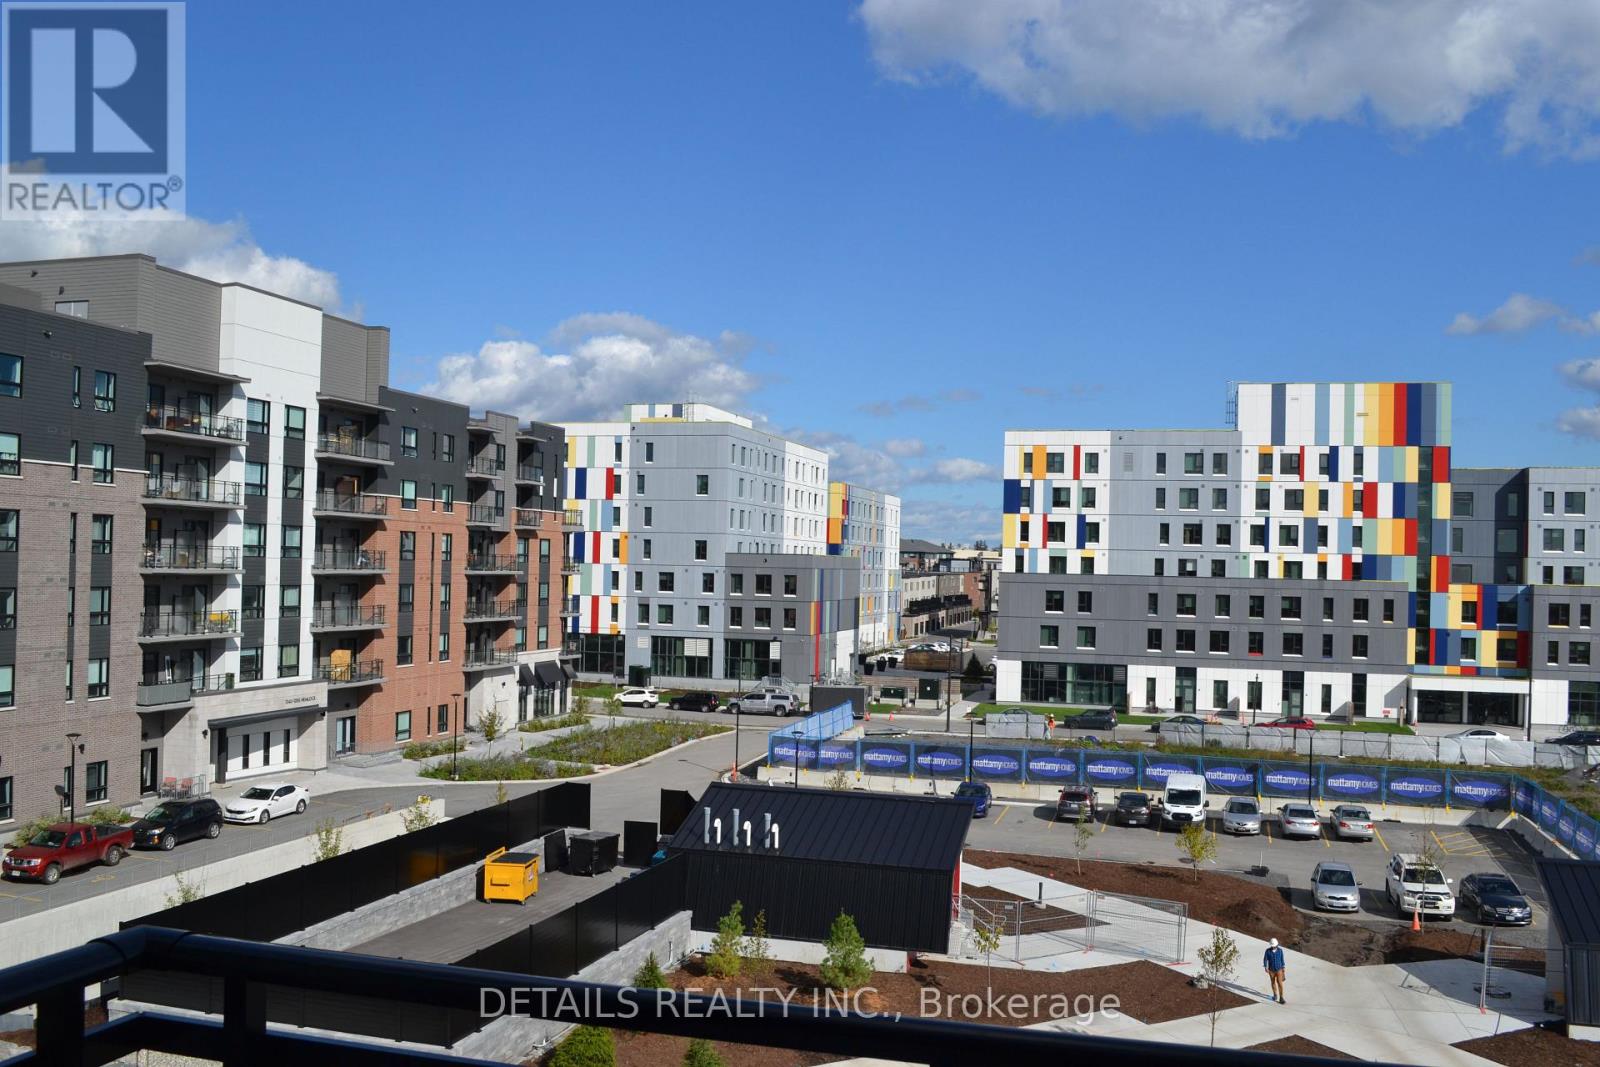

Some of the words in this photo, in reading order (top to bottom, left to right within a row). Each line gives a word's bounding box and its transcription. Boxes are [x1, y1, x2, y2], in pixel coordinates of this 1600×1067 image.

[863, 752, 907, 764] mattamyHOMES
[973, 758, 1019, 770] mattamyHOMES
[1030, 761, 1076, 773] mattamyHOMES
[1087, 764, 1135, 776] mattamyHOMES
[1206, 770, 1253, 782] mattamyHOMES
[1266, 774, 1316, 786] mattamyHOMS
[1328, 778, 1378, 790] mattamyHOMES
[1391, 781, 1442, 793] mattamyHOMES
